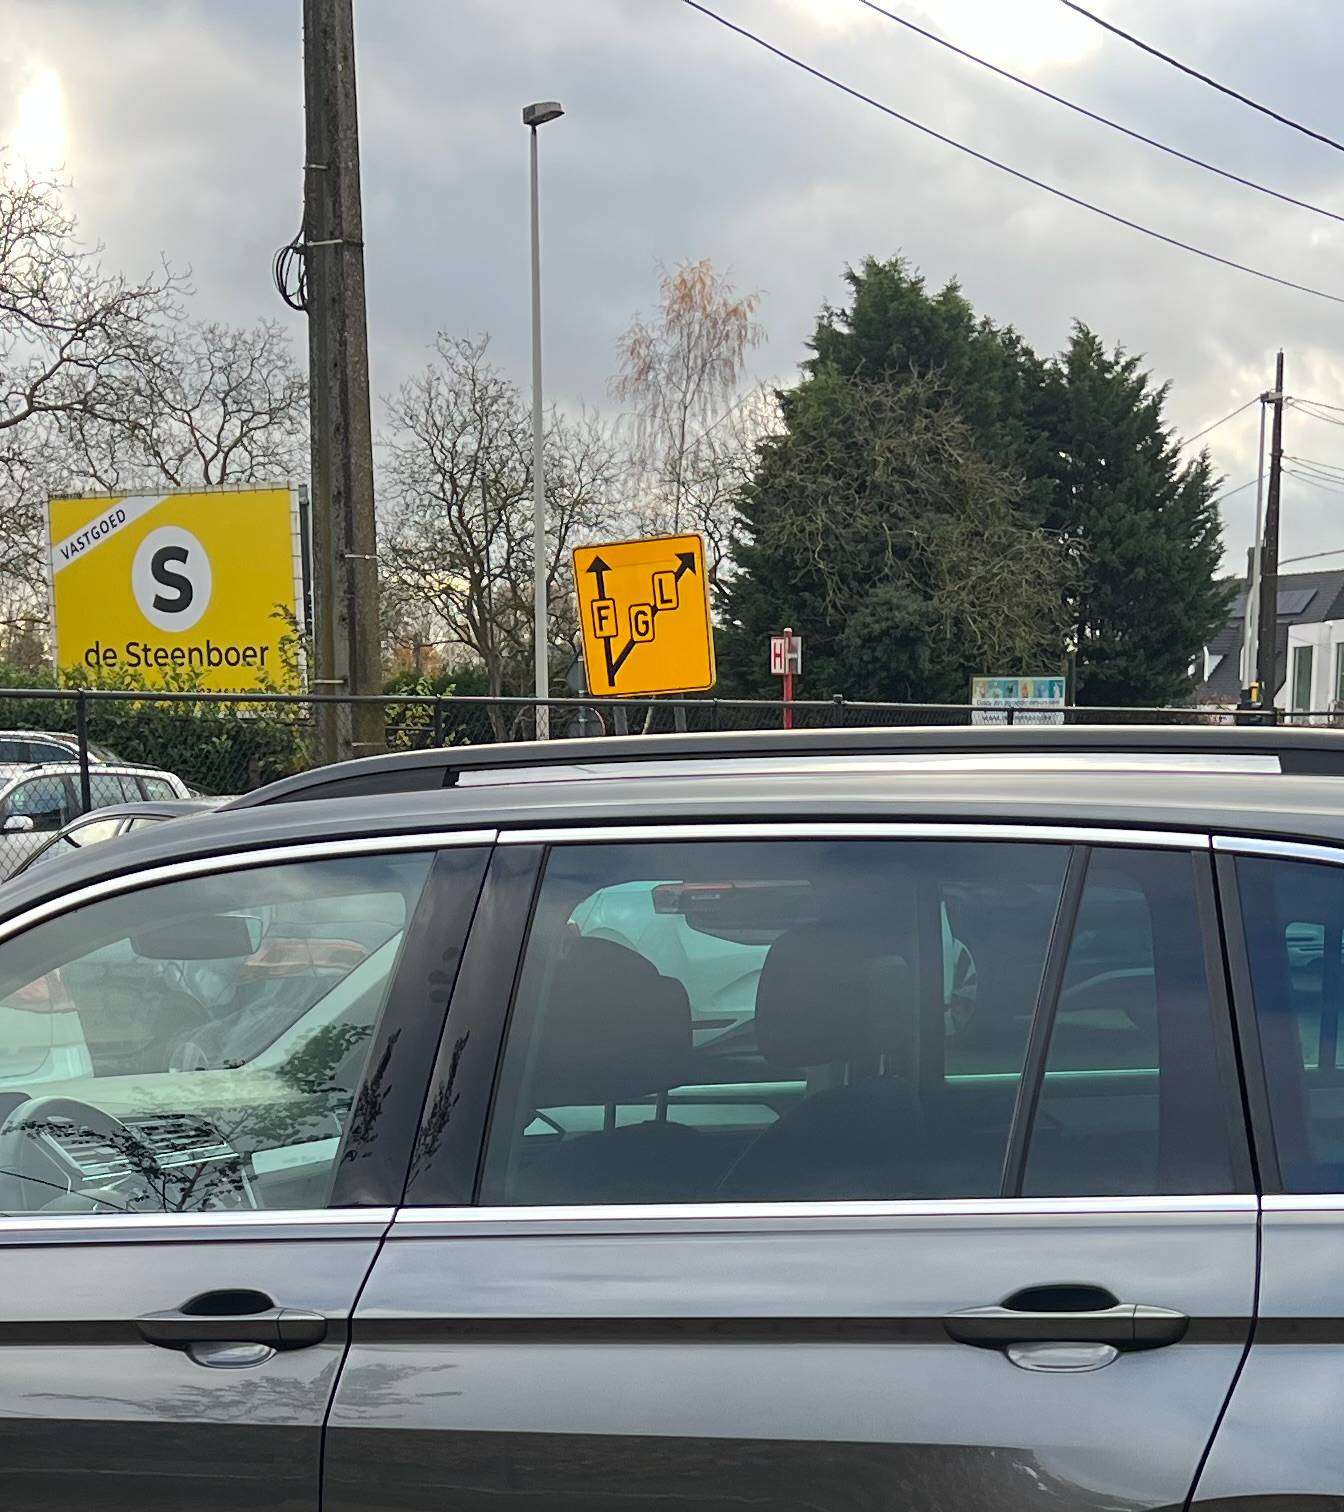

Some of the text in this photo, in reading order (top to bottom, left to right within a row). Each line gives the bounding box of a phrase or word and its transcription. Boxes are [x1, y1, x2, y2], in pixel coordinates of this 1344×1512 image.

[60, 509, 126, 560] VASTGOED
[150, 545, 193, 613] S
[658, 578, 673, 604] L
[597, 606, 611, 631] F
[634, 610, 650, 636] G
[85, 640, 269, 668] de Steenboer
